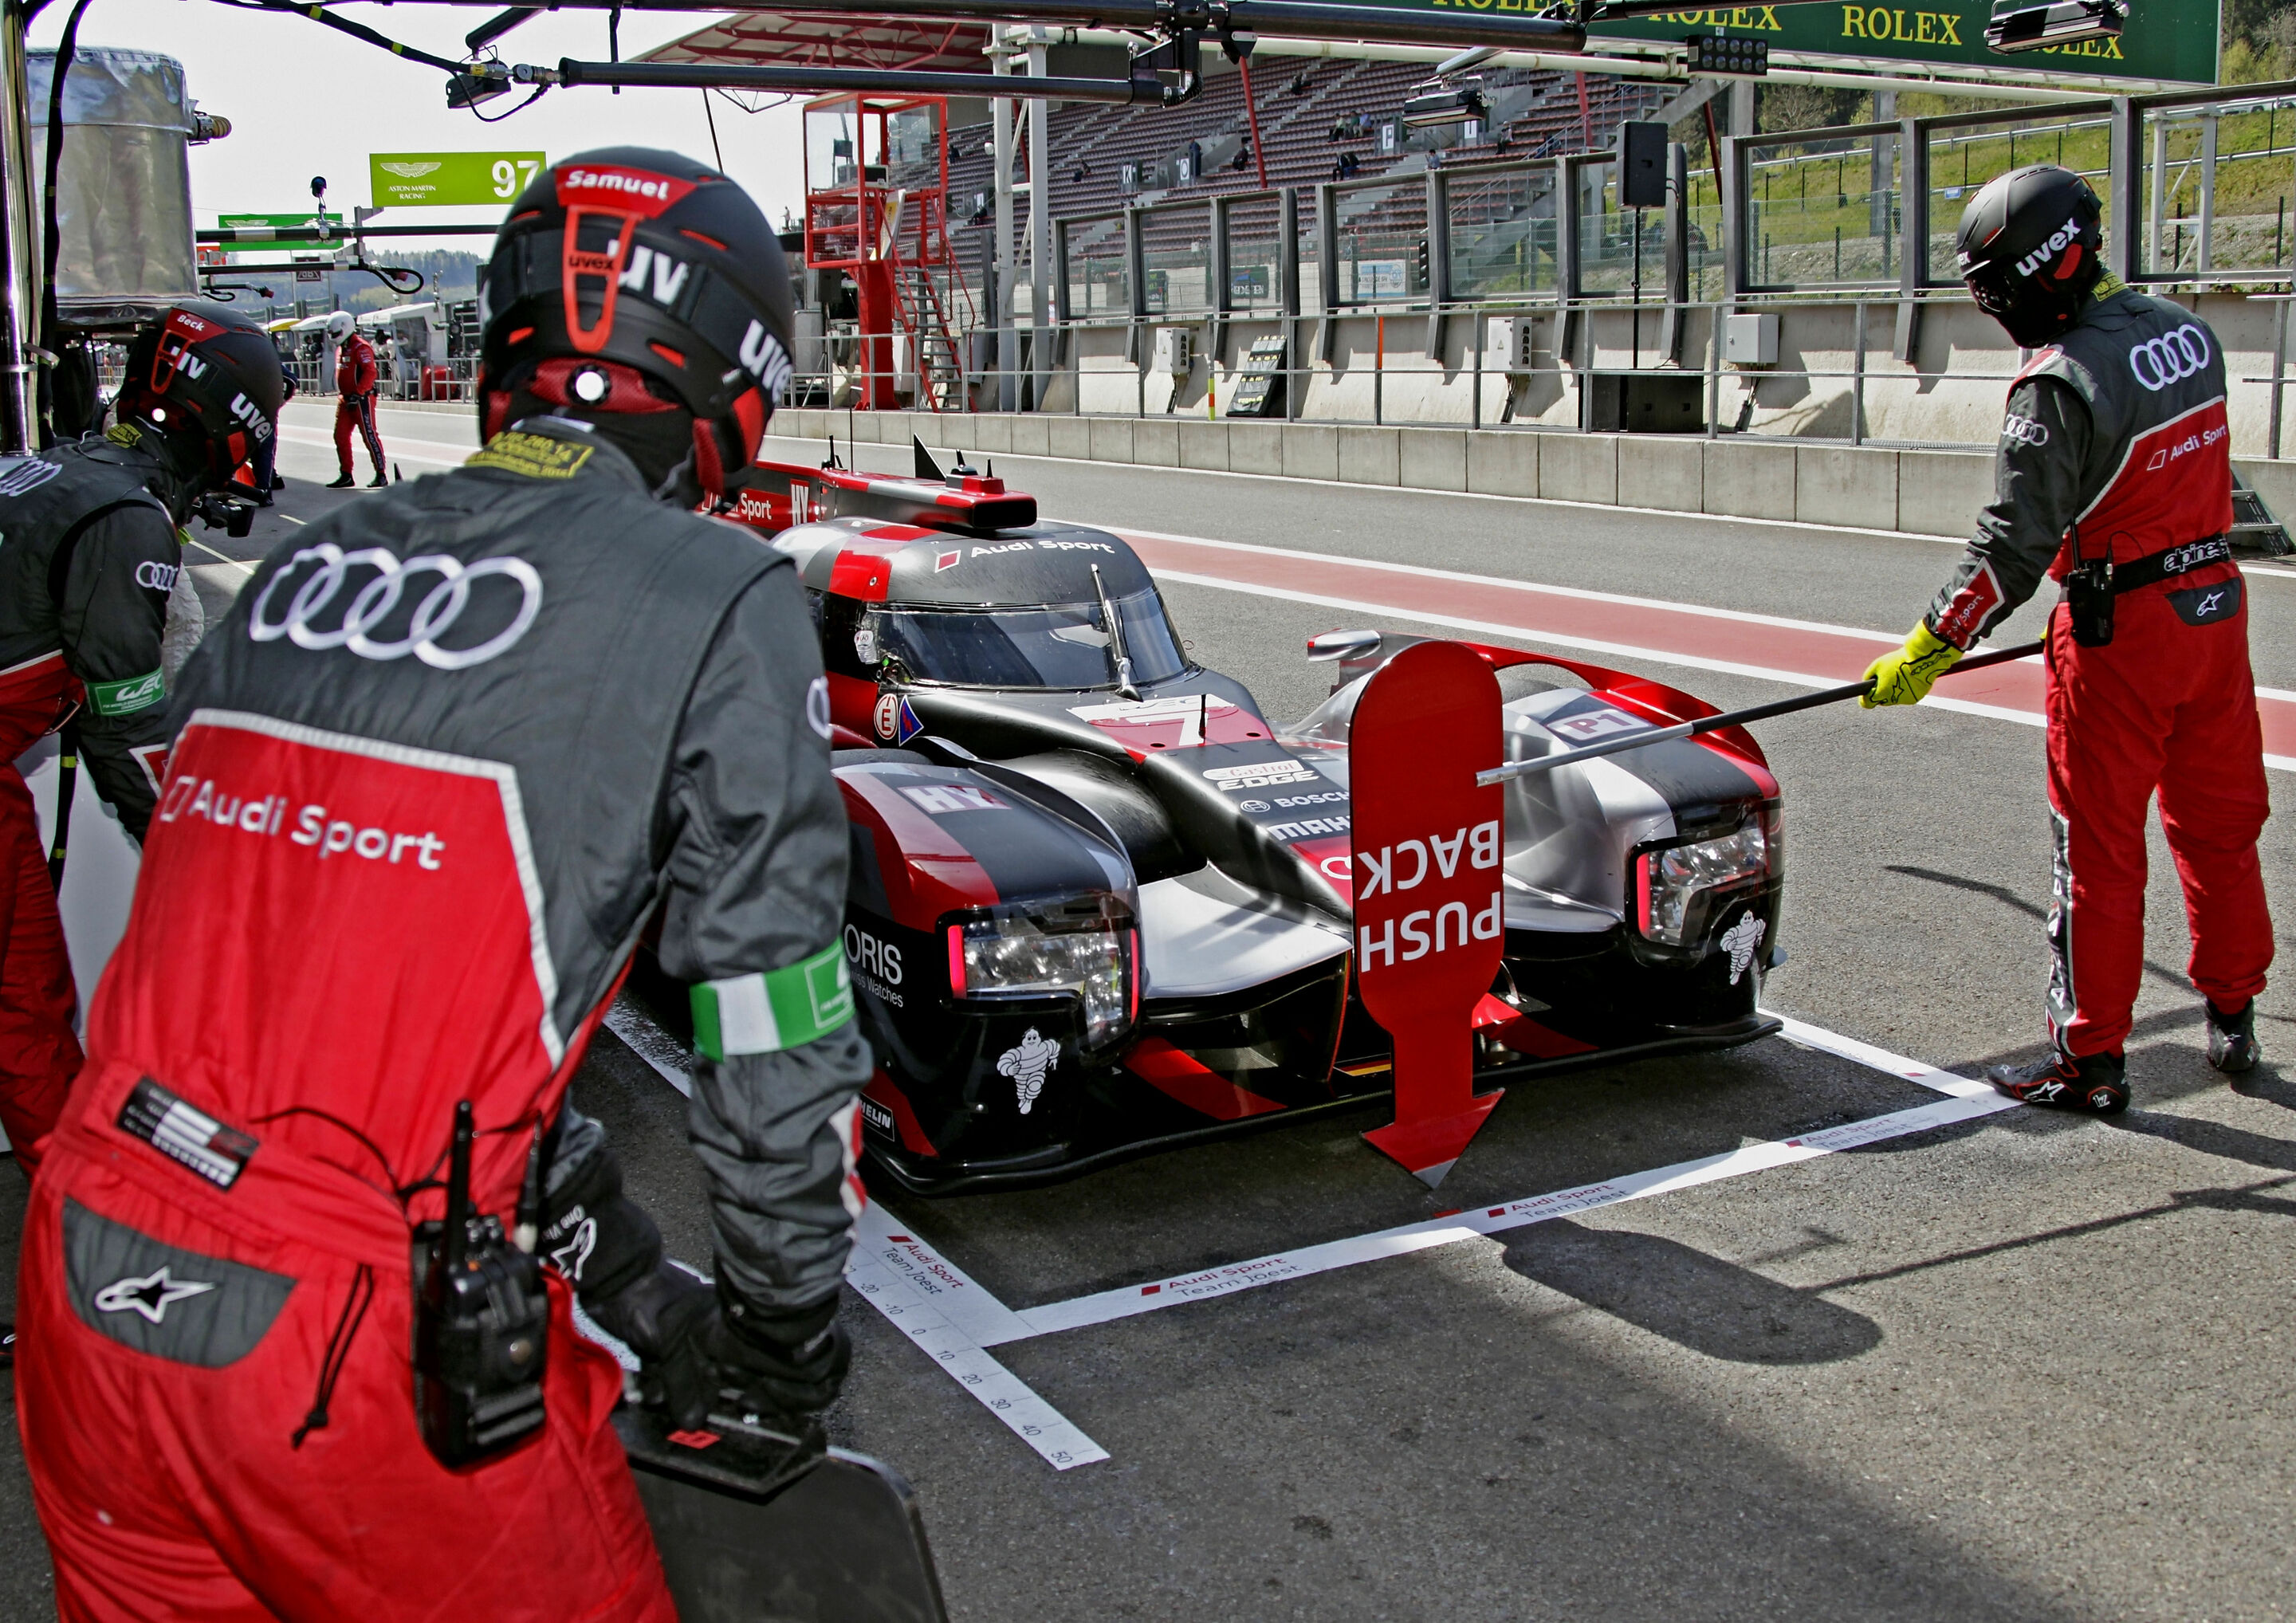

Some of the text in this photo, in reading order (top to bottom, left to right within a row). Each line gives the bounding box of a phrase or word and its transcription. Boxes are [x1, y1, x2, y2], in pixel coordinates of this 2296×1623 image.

[1842, 5, 1962, 45] ROLEX
[491, 159, 541, 198] 97
[565, 170, 670, 201] Samuel
[2015, 217, 2082, 277] uvex
[177, 314, 205, 332] Beck
[2170, 424, 2227, 461] Audi Sport
[741, 492, 773, 521] Sport
[790, 484, 809, 526] HY
[971, 540, 1116, 558] Audi Sport
[1126, 709, 1209, 746] 7
[1563, 713, 1633, 734] P1
[1217, 770, 1320, 792] EDGE
[1229, 762, 1295, 777] Castrol
[903, 787, 994, 812] HY
[187, 780, 446, 871] Audi Sport
[1266, 815, 1350, 841] MAH
[1357, 819, 1499, 901] BACK
[1360, 891, 1500, 973] PUSH
[844, 923, 902, 985] ORIS
[867, 975, 904, 1008] Watches
[1805, 1118, 1895, 1143] Audi Sport
[1816, 1134, 1866, 1149] Team
[1512, 1184, 1614, 1212] Audi Sport
[1520, 1189, 1632, 1218] Team Joest
[882, 1247, 943, 1295] Team Joest
[902, 1244, 965, 1289] Audi Sport
[1169, 1257, 1287, 1289] Audi Sport
[1175, 1264, 1303, 1297] Team Joest
[860, 1283, 879, 1294] -20
[886, 1304, 903, 1315] -10
[937, 1350, 955, 1361] 10
[961, 1373, 983, 1385] 20
[990, 1398, 1012, 1410] 30
[1021, 1425, 1042, 1436] 40
[1051, 1451, 1073, 1464] 50
